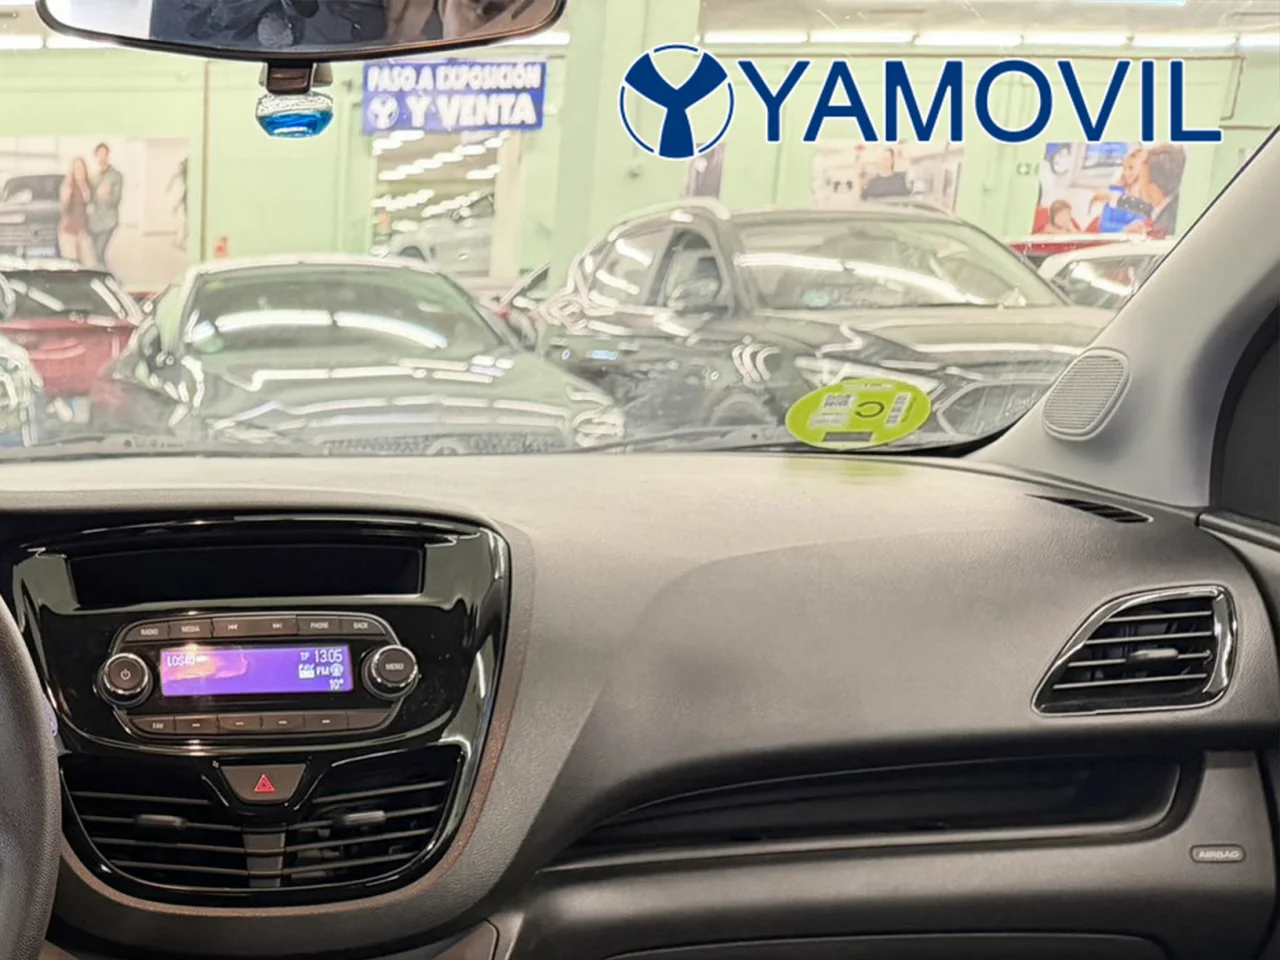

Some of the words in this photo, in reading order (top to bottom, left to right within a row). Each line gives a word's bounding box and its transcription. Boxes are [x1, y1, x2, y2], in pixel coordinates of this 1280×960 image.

[368, 66, 416, 91] PASO
[419, 66, 434, 90] A
[405, 95, 433, 127] Y
[436, 93, 537, 130] VENTA
[1199, 850, 1240, 858] AIRBAG
